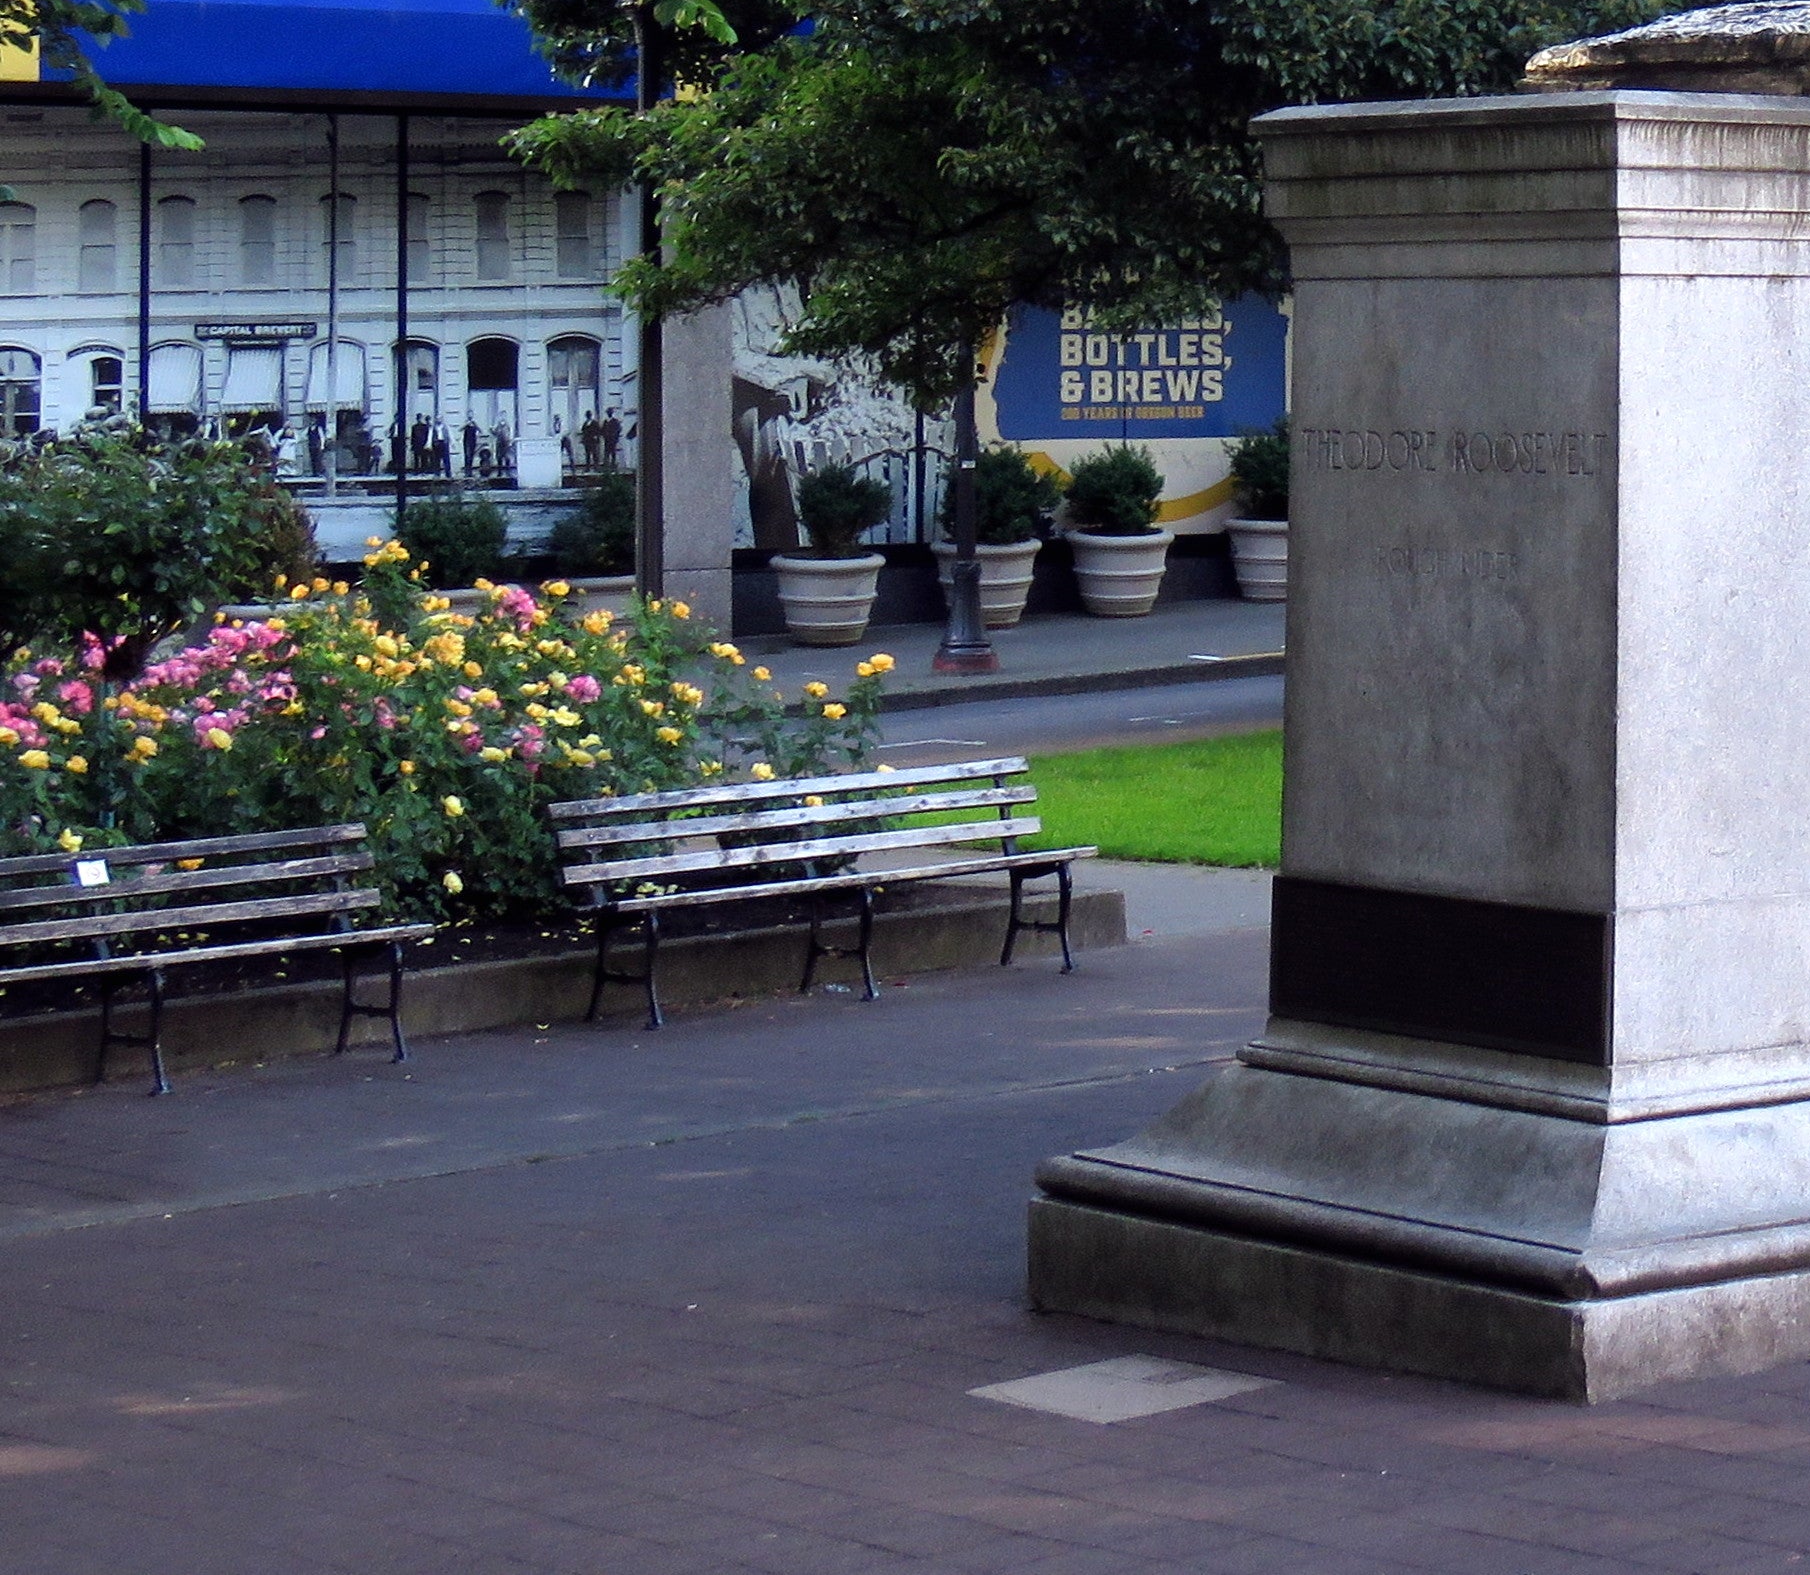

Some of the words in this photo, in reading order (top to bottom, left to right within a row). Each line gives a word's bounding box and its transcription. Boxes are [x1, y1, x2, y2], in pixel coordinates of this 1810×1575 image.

[1060, 333, 1232, 371] BOTTLES,
[1060, 370, 1085, 403] &
[1090, 369, 1223, 403] BREWS
[1300, 428, 1437, 472] THEODORE
[1451, 429, 1608, 476] ROOSEVELT
